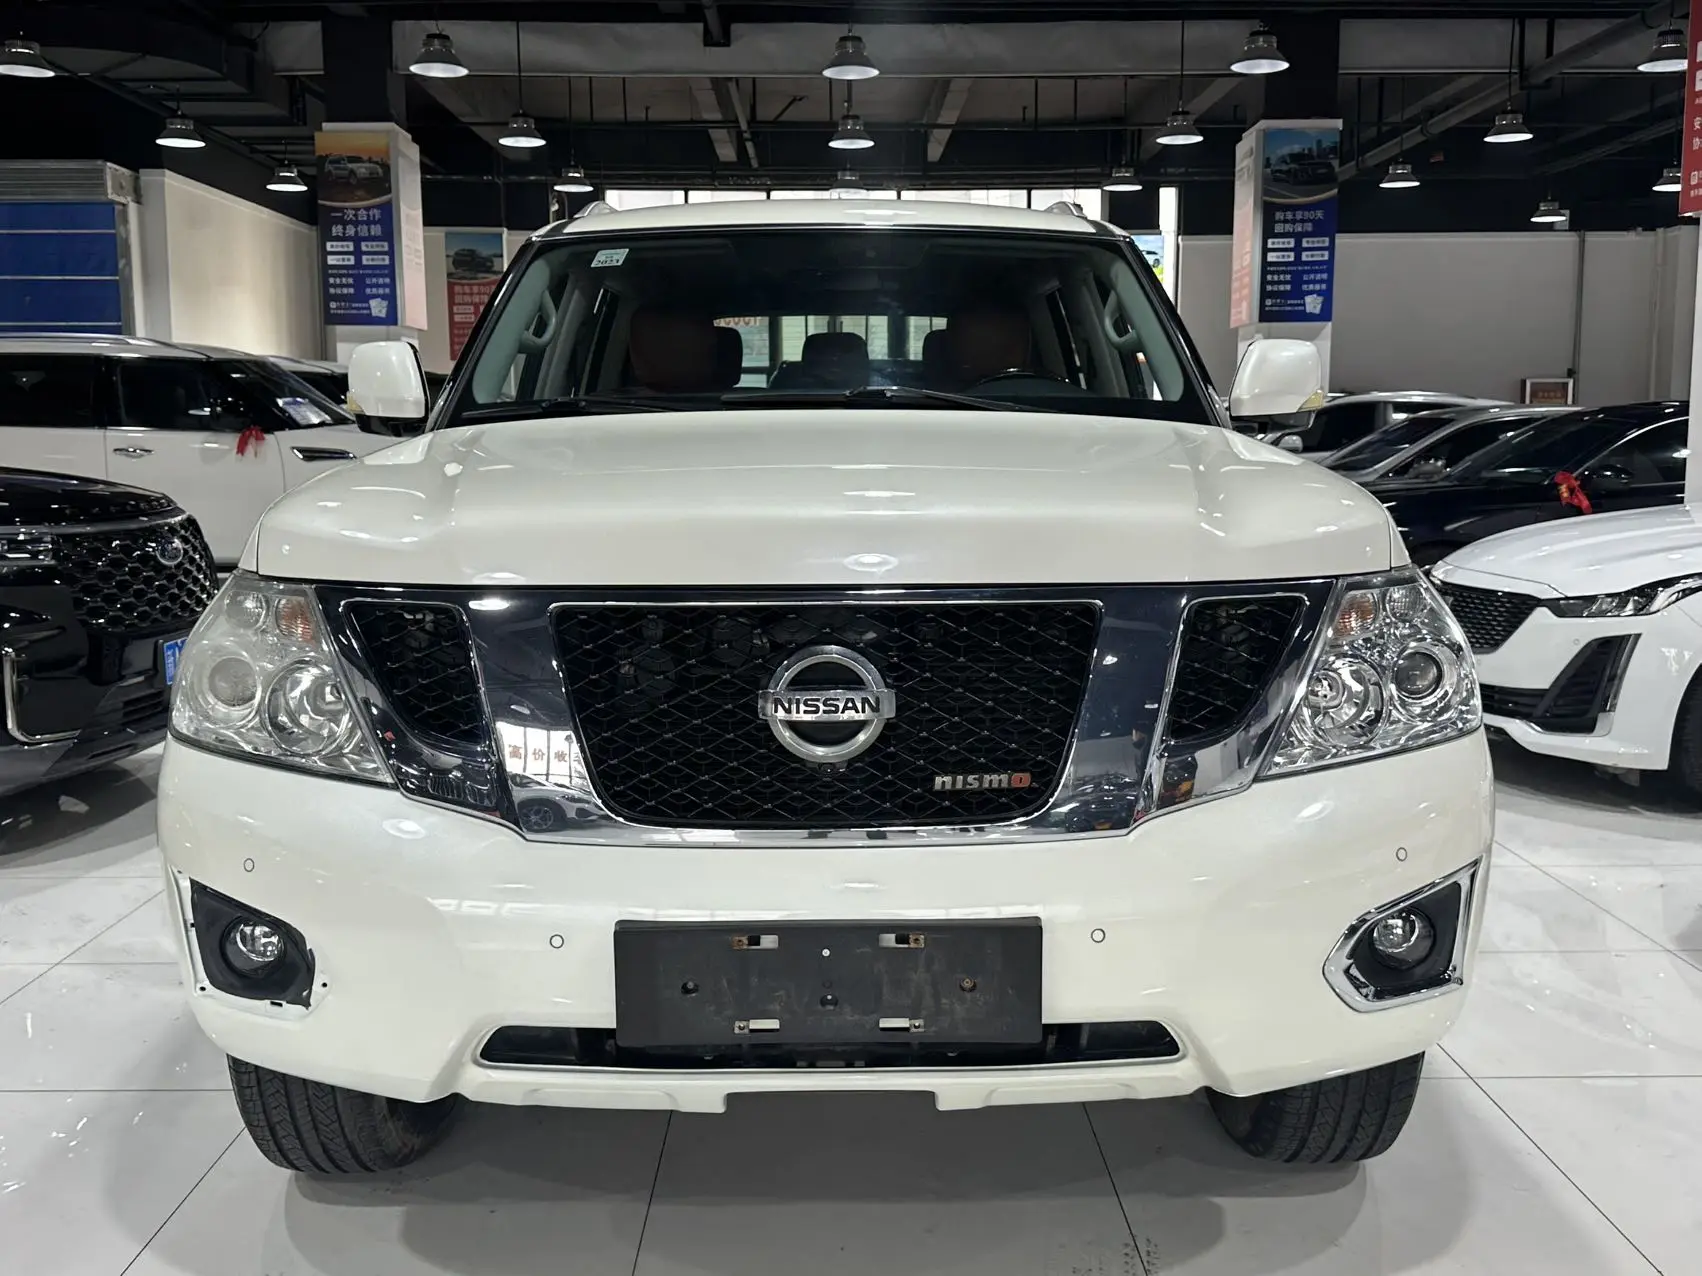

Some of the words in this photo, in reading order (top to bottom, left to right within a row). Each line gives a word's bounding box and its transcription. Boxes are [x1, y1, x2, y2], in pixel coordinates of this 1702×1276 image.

[330, 208, 382, 221] 一次合作
[331, 224, 383, 237] 终身信赖
[773, 696, 880, 715] NISSAN
[934, 773, 1032, 791] nismo
